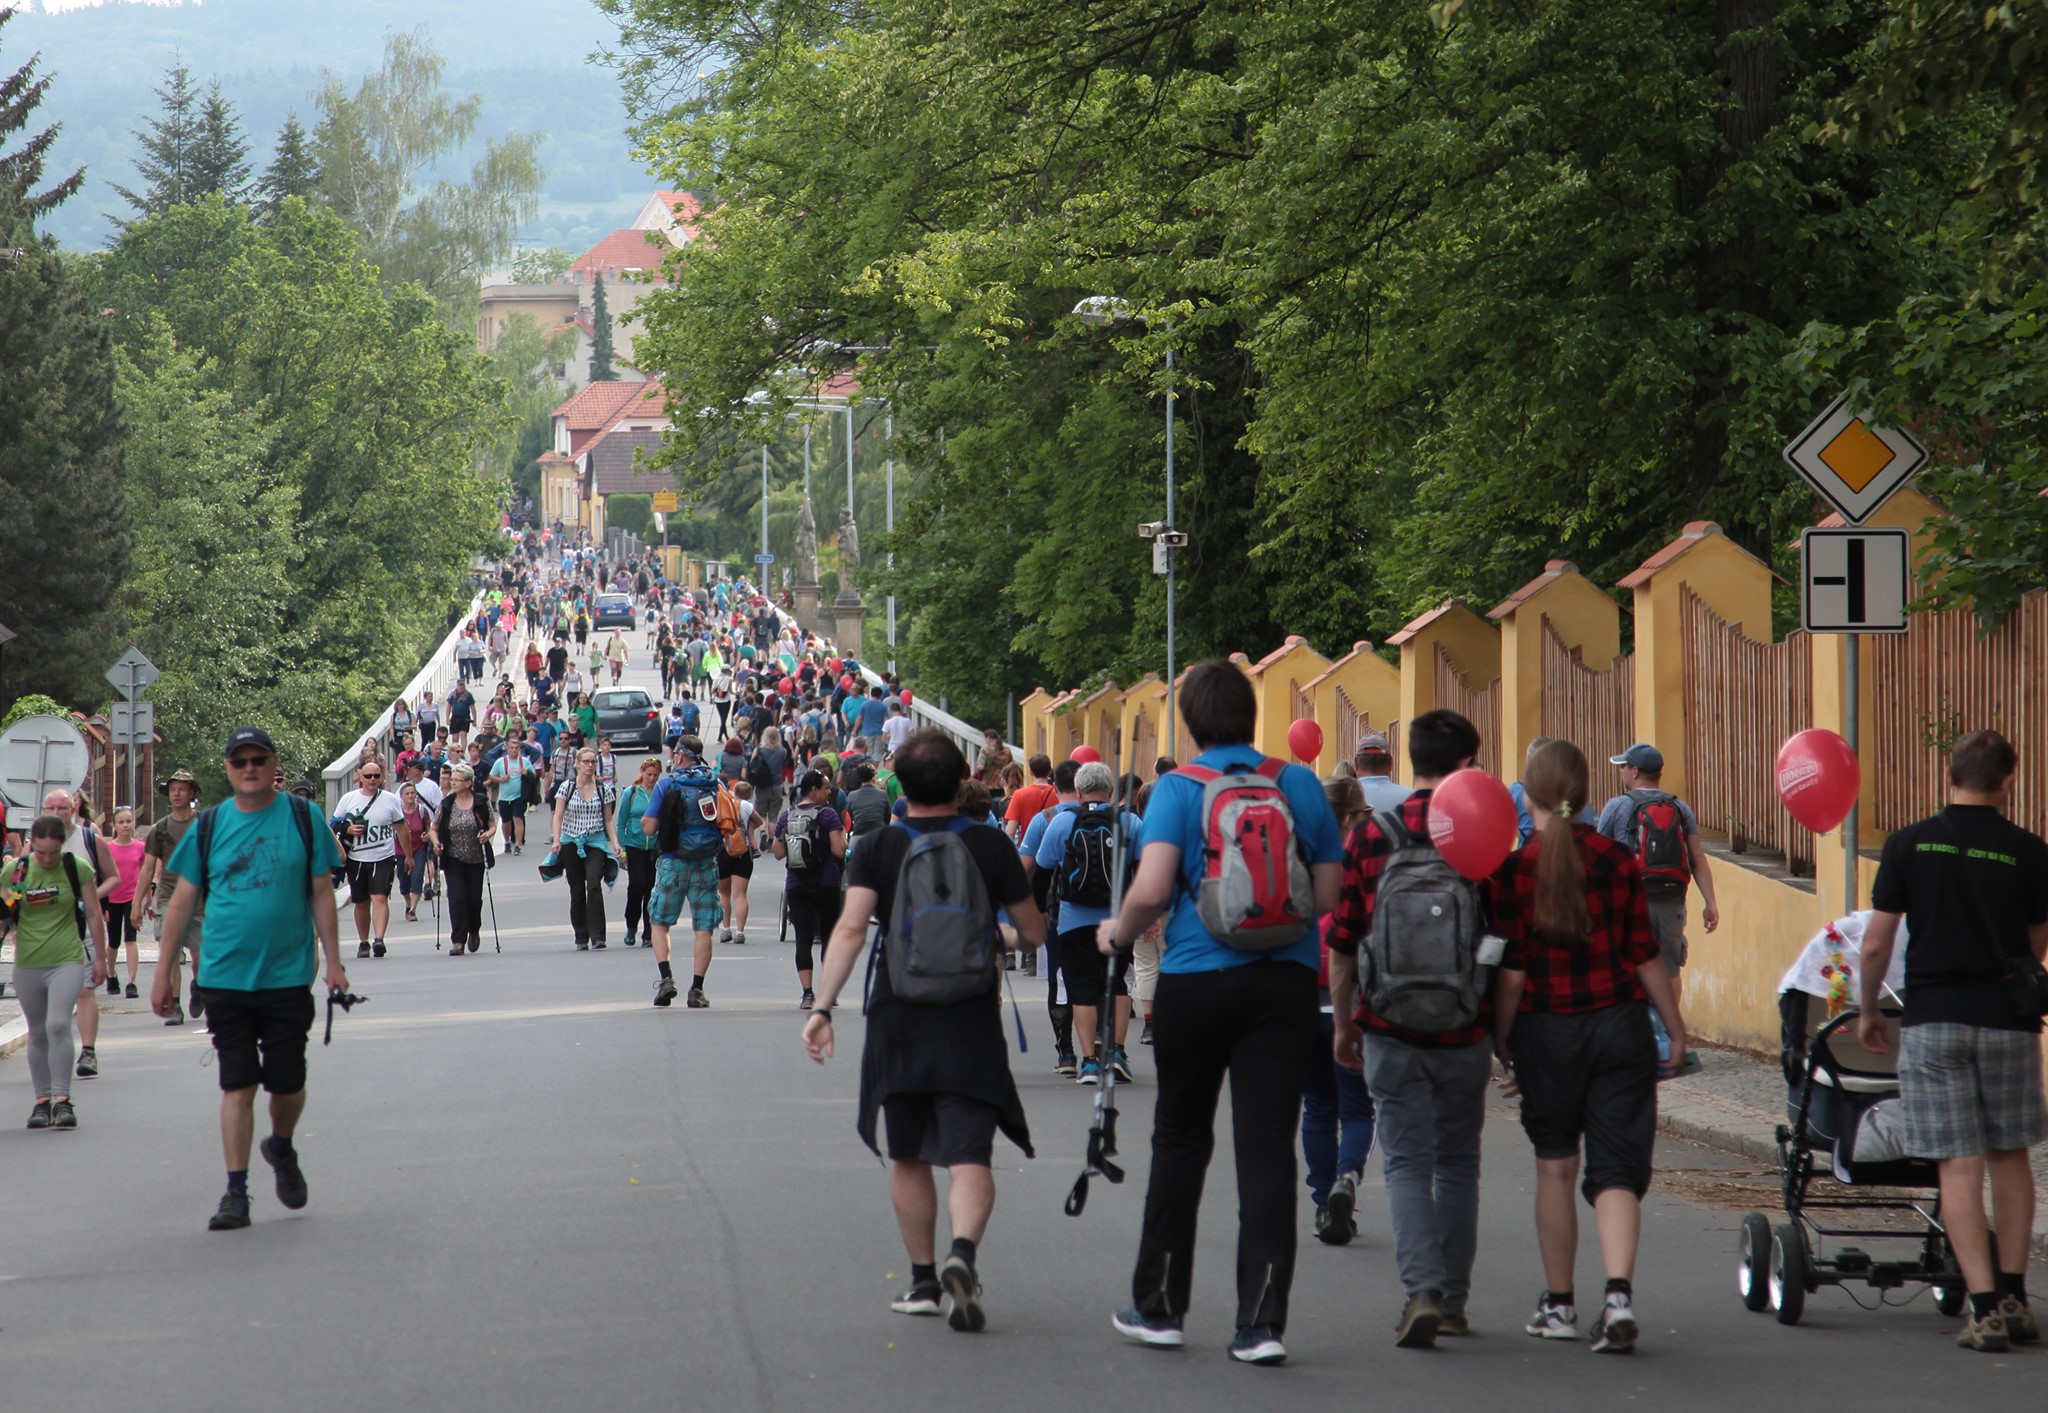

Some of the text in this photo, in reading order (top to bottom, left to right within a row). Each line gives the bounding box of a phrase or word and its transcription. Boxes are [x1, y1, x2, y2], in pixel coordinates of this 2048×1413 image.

[1916, 843, 1931, 852] PRO
[1988, 852, 1998, 860] NA
[2000, 854, 2017, 866] KOLE
